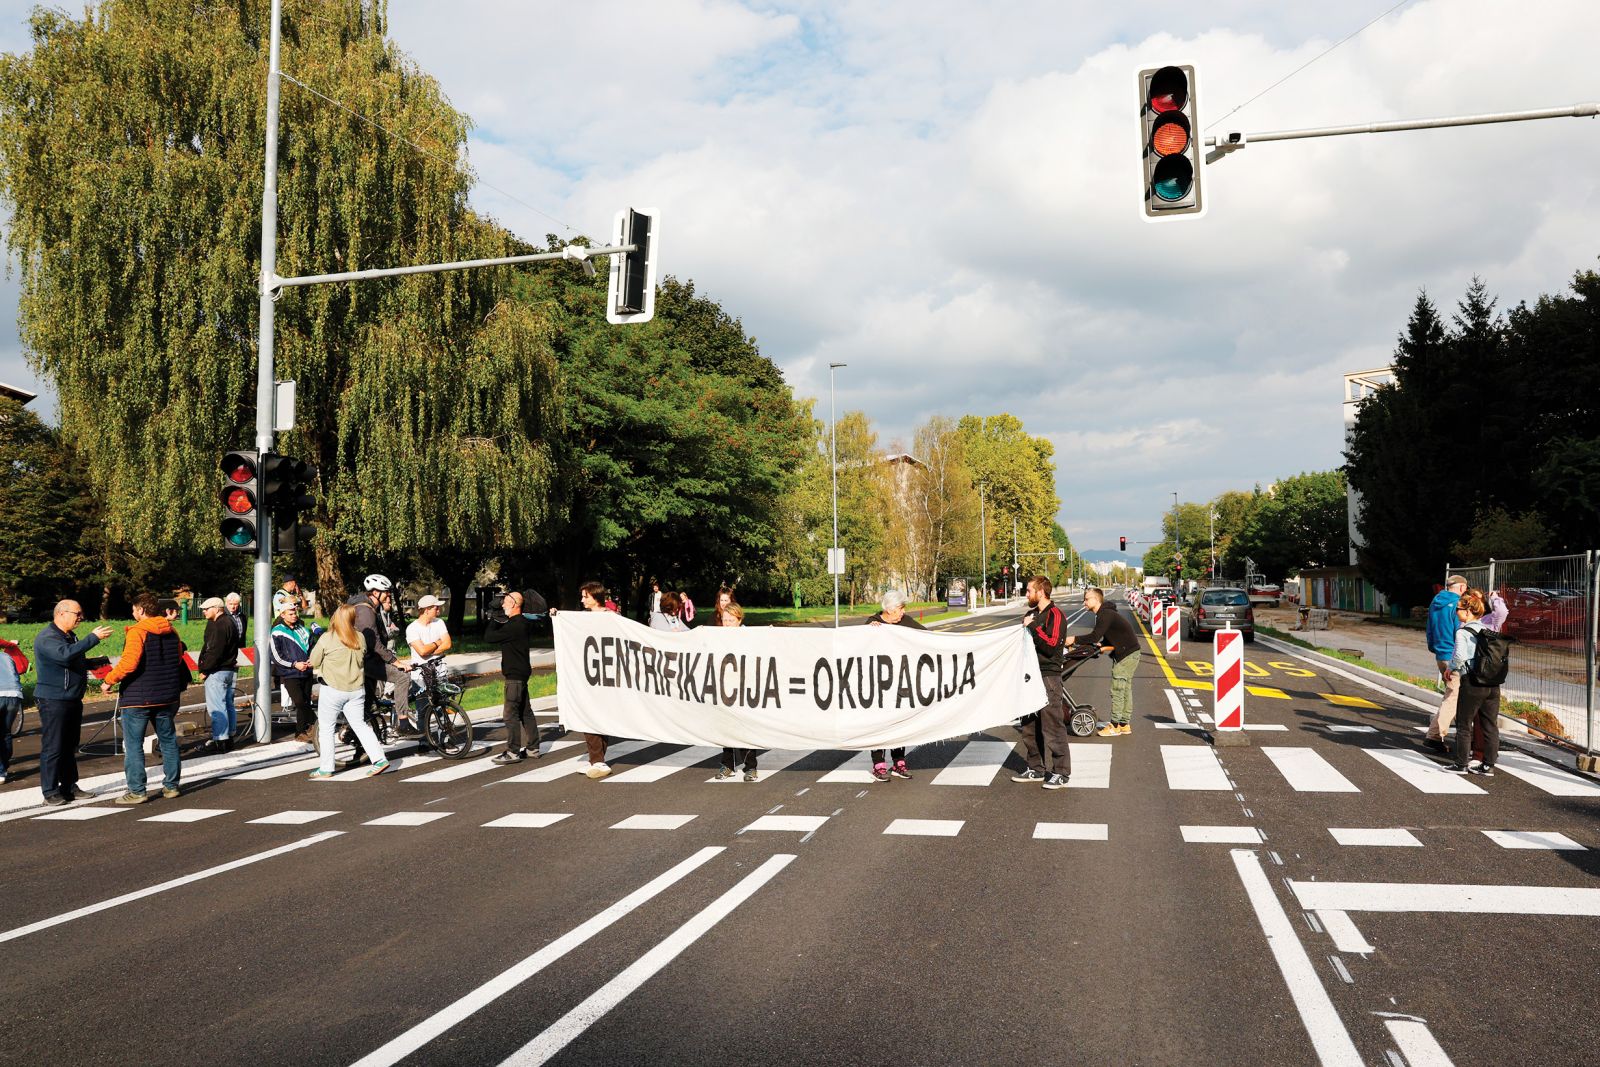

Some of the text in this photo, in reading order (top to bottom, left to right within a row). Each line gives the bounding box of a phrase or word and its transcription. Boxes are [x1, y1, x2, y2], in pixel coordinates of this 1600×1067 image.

[583, 635, 976, 711] GENTRIFIKACIJA = OKUPACIJA
